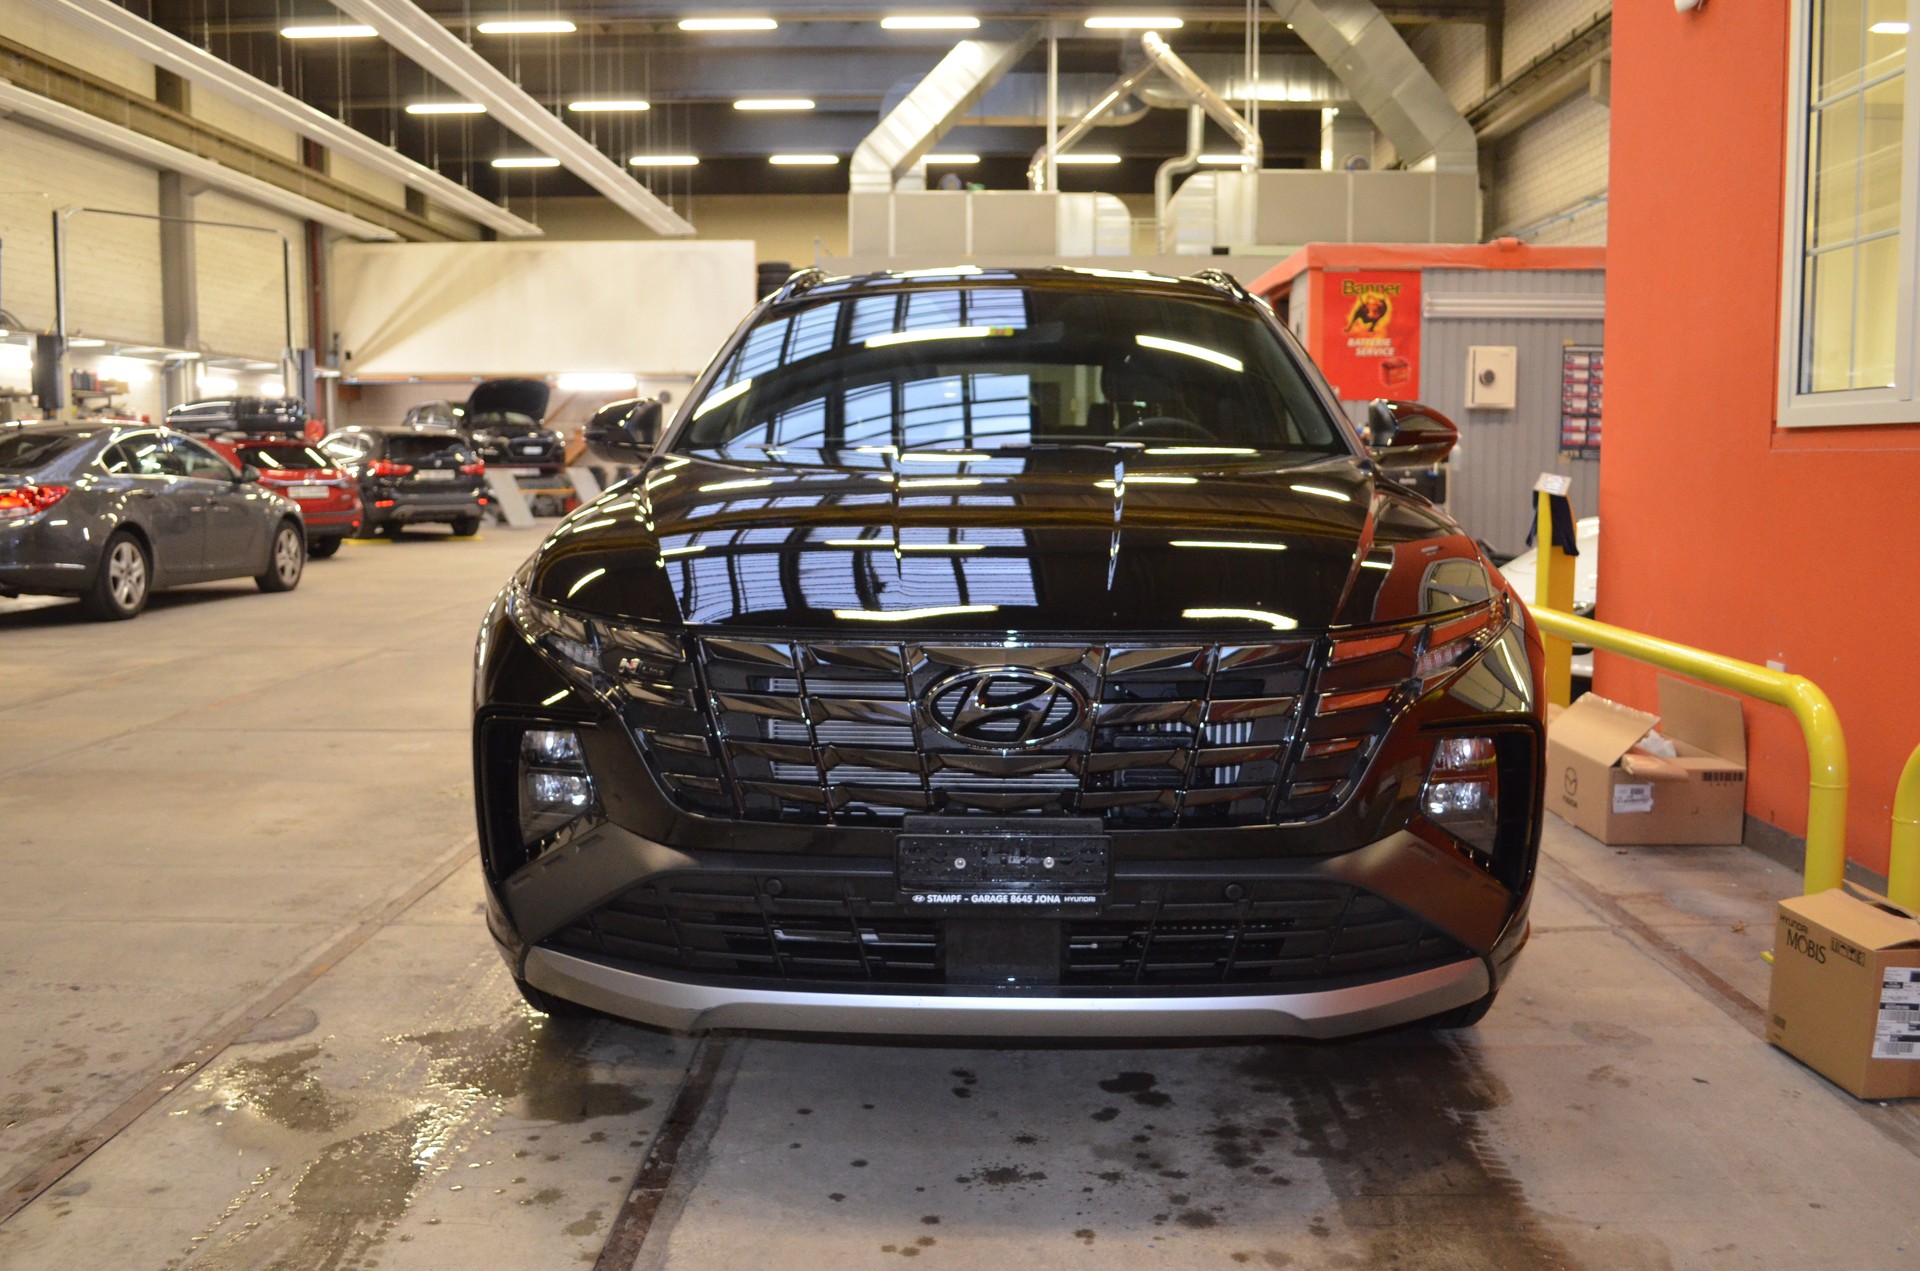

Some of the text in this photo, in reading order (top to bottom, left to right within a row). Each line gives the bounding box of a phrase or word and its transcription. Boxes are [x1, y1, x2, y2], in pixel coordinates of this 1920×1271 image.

[1344, 280, 1401, 295] Banner
[1348, 338, 1391, 347] BATTERIE
[1356, 347, 1395, 356] SERVICE
[926, 894, 962, 903] STAMPF
[971, 894, 1008, 903] GARAGE
[1010, 894, 1033, 903] 8645
[1035, 894, 1061, 903] JONA
[1064, 895, 1096, 903] HYUNDAI
[1787, 929, 1826, 964] MOBIS
